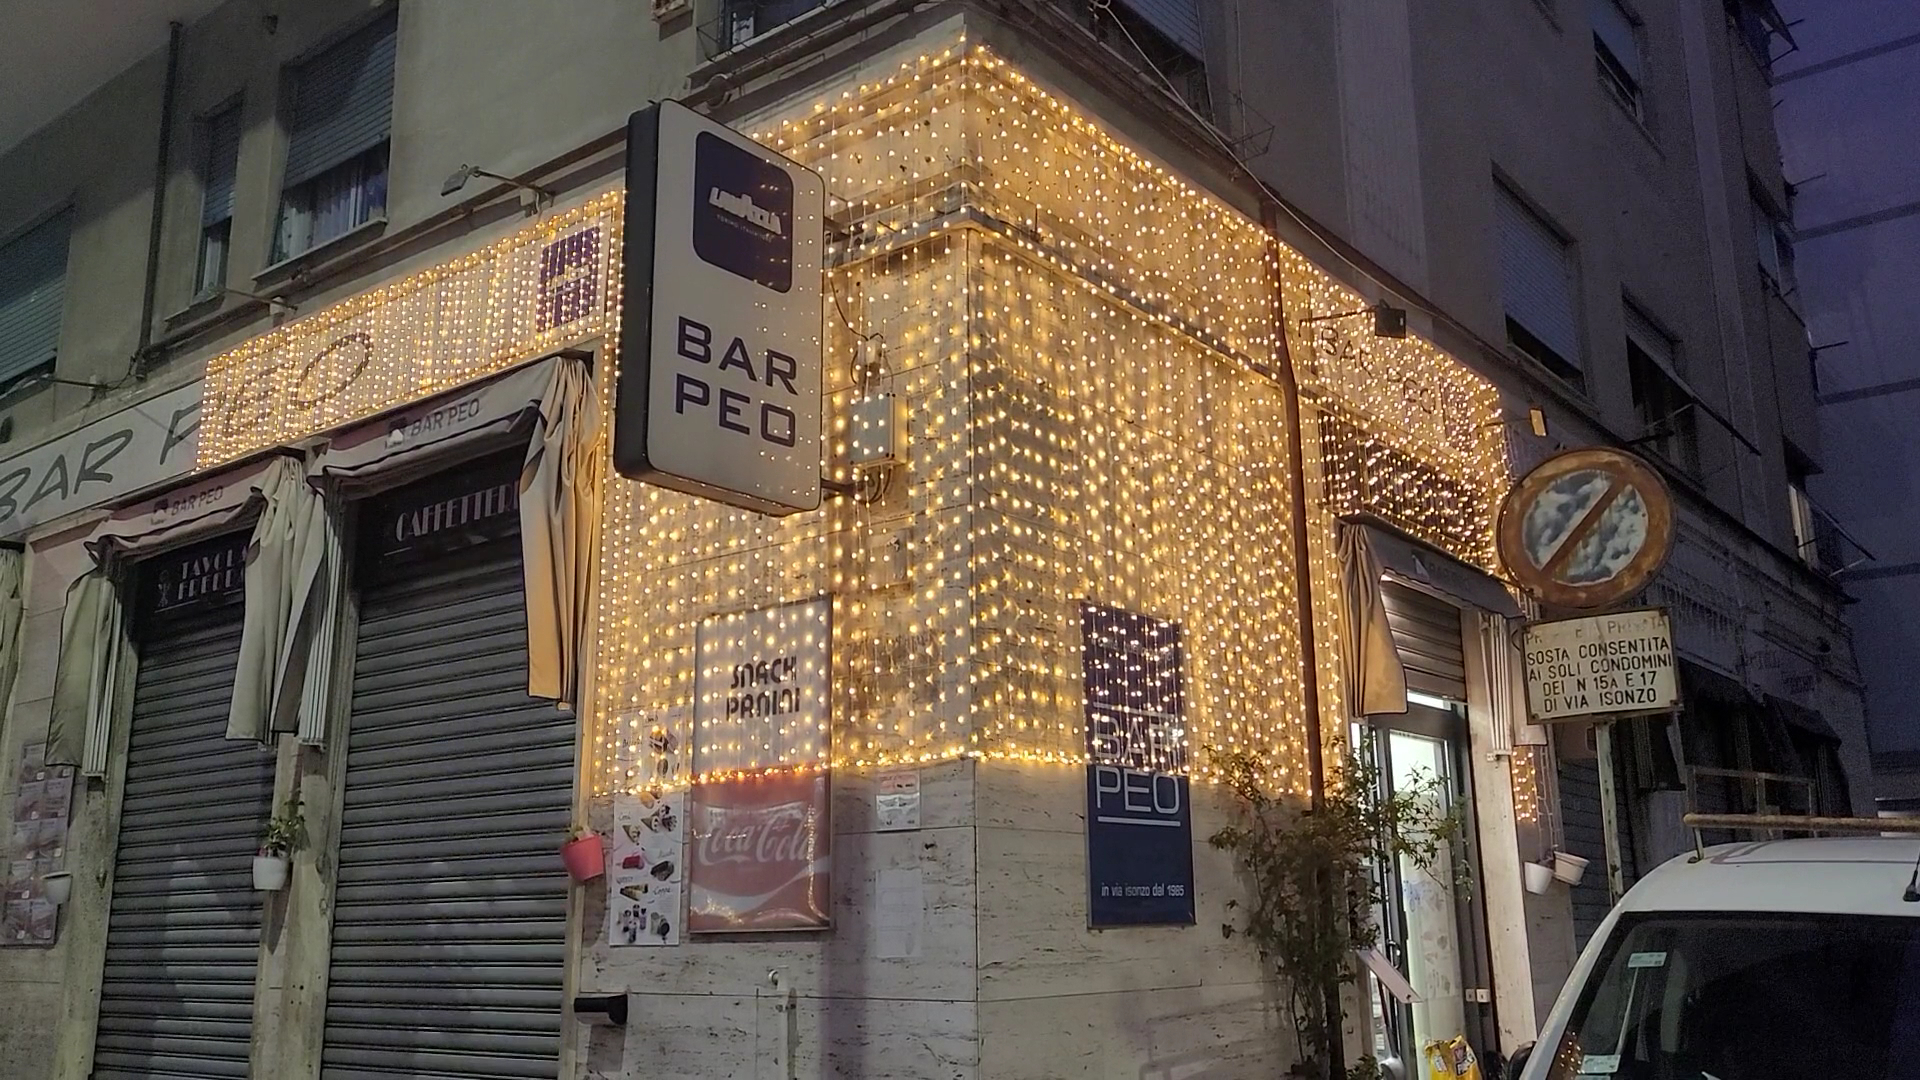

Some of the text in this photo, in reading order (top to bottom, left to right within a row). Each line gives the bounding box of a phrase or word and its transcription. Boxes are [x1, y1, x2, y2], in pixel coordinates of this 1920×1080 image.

[678, 315, 798, 395] BAR
[410, 399, 480, 437] BAR PEO
[676, 373, 796, 447] PEO
[171, 486, 223, 516] BAR PEO
[396, 479, 520, 542] CAFFETTERI
[1527, 637, 1669, 666] SOSTA CONSENTITA
[1548, 662, 1581, 679] SOLI
[1591, 654, 1672, 674] CONDOMINI
[730, 655, 797, 690] SNACK
[1543, 681, 1565, 697] DEI
[1626, 673, 1634, 687] E
[1640, 671, 1657, 686] 17
[726, 688, 800, 721] PANINI
[1544, 688, 1656, 713] DI VIA ISONZO
[1094, 715, 1178, 769] BAR
[1096, 766, 1179, 814] PEO
[1101, 883, 1184, 897] in via isonzo dal 1985
